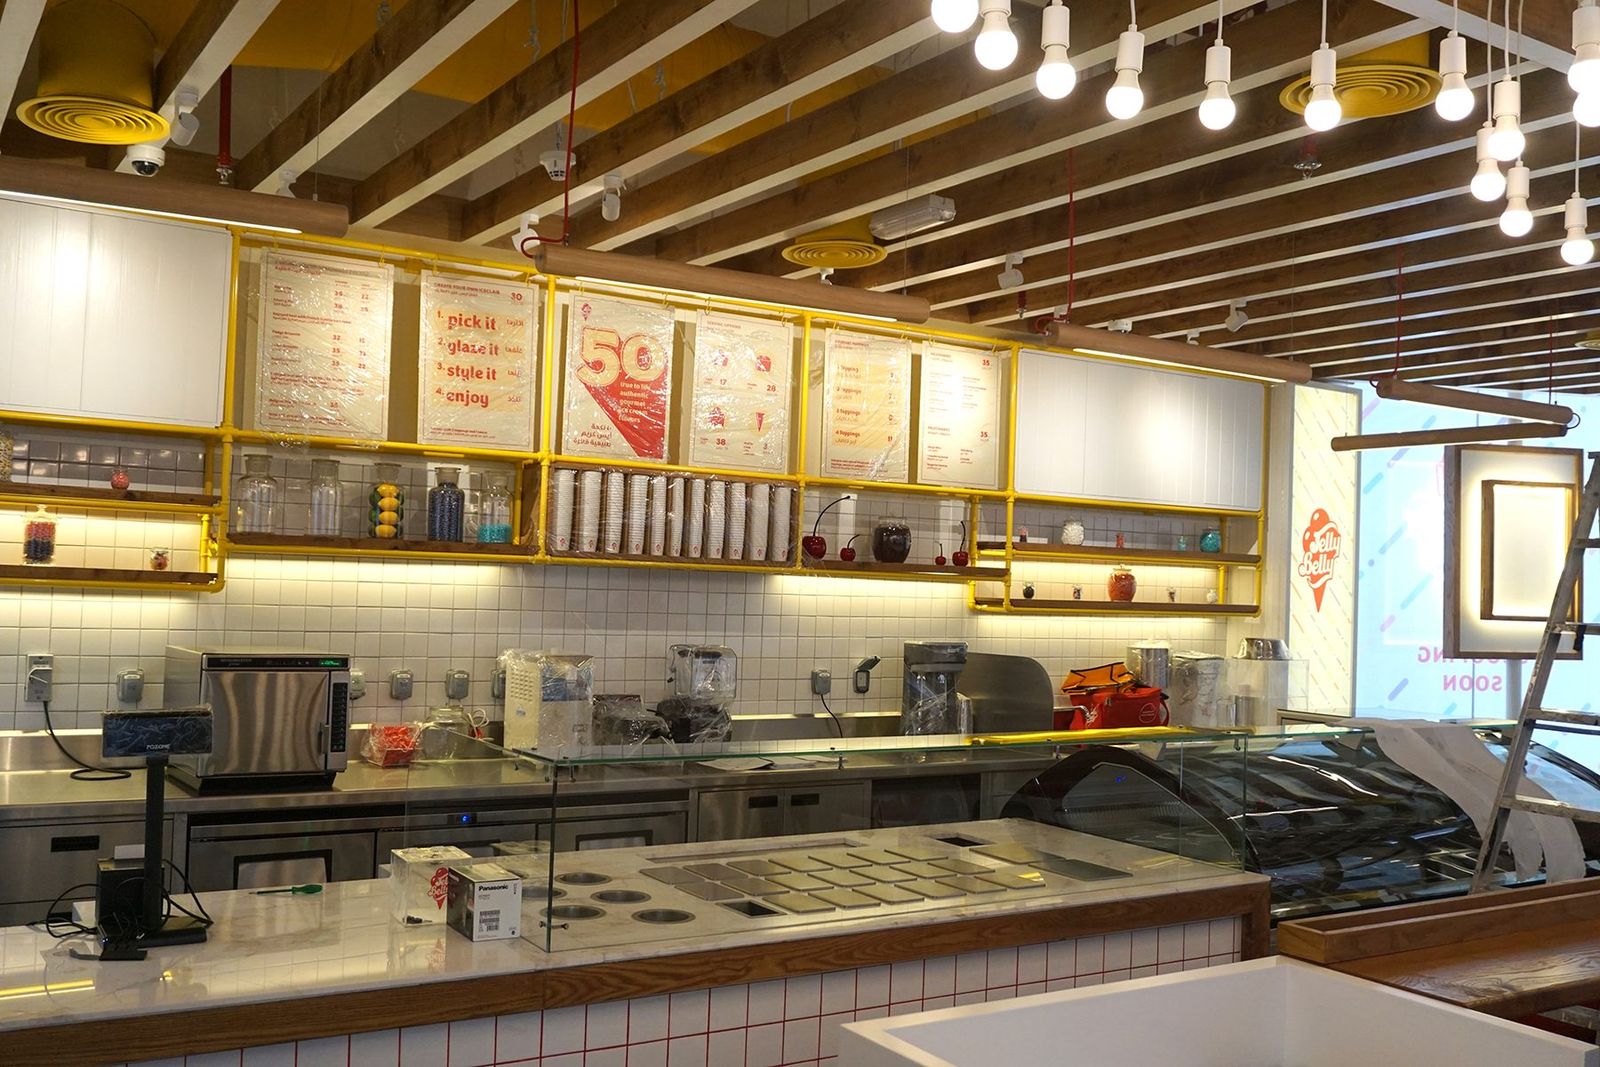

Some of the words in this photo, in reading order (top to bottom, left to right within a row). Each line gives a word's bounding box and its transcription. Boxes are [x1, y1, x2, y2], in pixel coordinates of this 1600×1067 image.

[510, 291, 523, 302] 30
[437, 310, 444, 319] 1.
[448, 313, 482, 330] pick
[485, 316, 497, 331] it
[448, 339, 487, 356] glaze
[489, 343, 499, 356] it
[575, 326, 668, 388] 50
[437, 362, 446, 371] 3.
[447, 365, 484, 381] style
[486, 367, 497, 381] it
[620, 381, 633, 389] true
[766, 384, 777, 392] 28
[435, 386, 445, 395] 4.
[446, 390, 489, 409] enjoy
[619, 390, 649, 399] authentic
[715, 438, 727, 446] 38
[1309, 531, 1341, 558] Jelly
[1298, 551, 1334, 578] Belly
[478, 884, 509, 892] Panasonic
